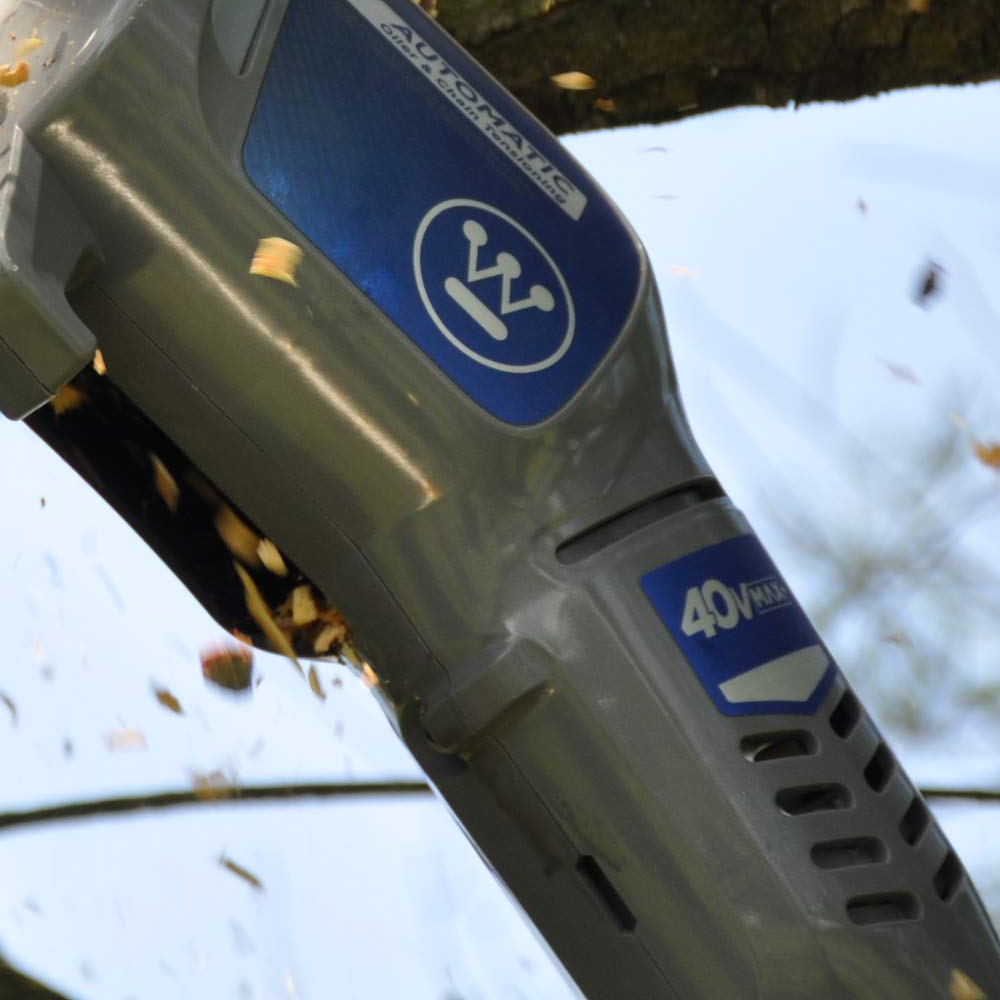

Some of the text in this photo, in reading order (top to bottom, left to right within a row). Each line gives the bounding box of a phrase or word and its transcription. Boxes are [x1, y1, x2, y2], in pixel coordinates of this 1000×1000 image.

[380, 23, 568, 205] Oiler & Chain Tensioning
[389, 23, 576, 196] AUTOMATIC
